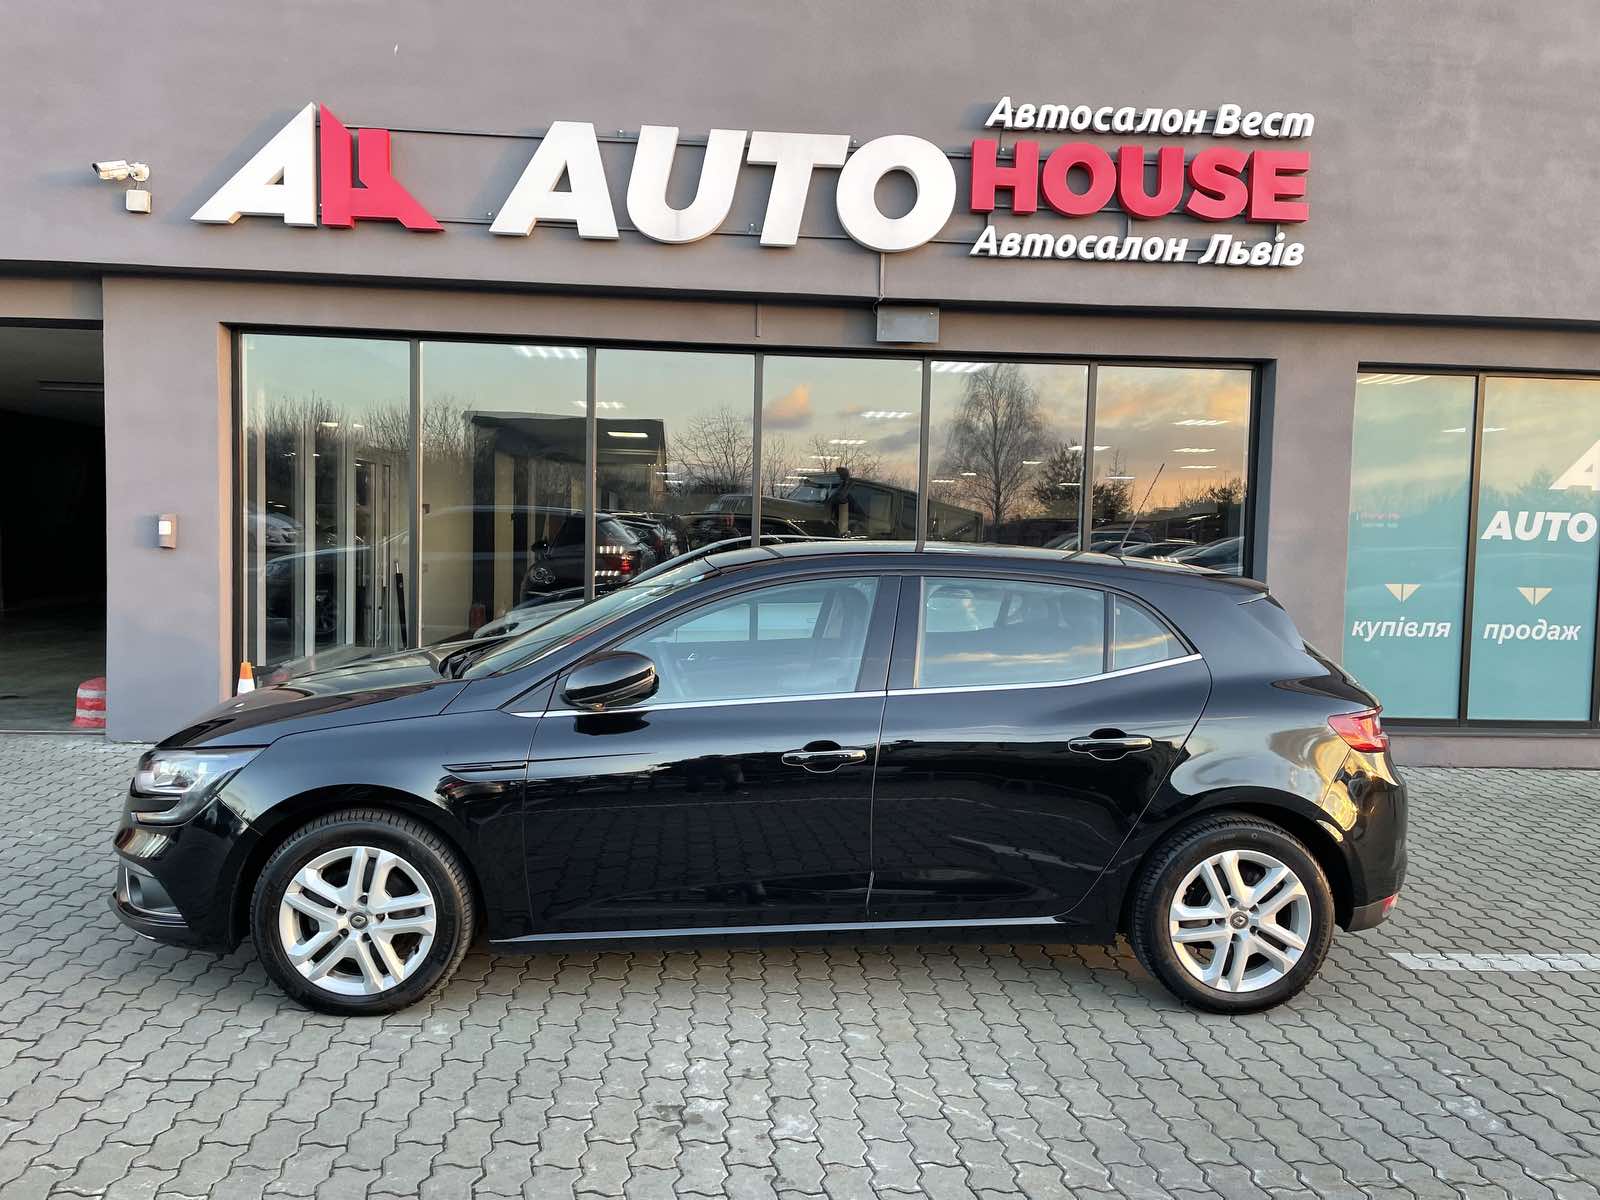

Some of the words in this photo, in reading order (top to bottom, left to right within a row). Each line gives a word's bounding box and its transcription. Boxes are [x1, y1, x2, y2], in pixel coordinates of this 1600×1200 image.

[985, 97, 1206, 136] Автосалон
[1213, 104, 1315, 138] Вест
[489, 121, 957, 252] AUTO
[971, 139, 1310, 223] HOUSE
[970, 225, 1188, 262] Автосалон
[1197, 232, 1306, 267] Львів
[1480, 510, 1598, 543] AUTO
[1351, 616, 1451, 642] купівля
[1483, 619, 1582, 644] продаж
